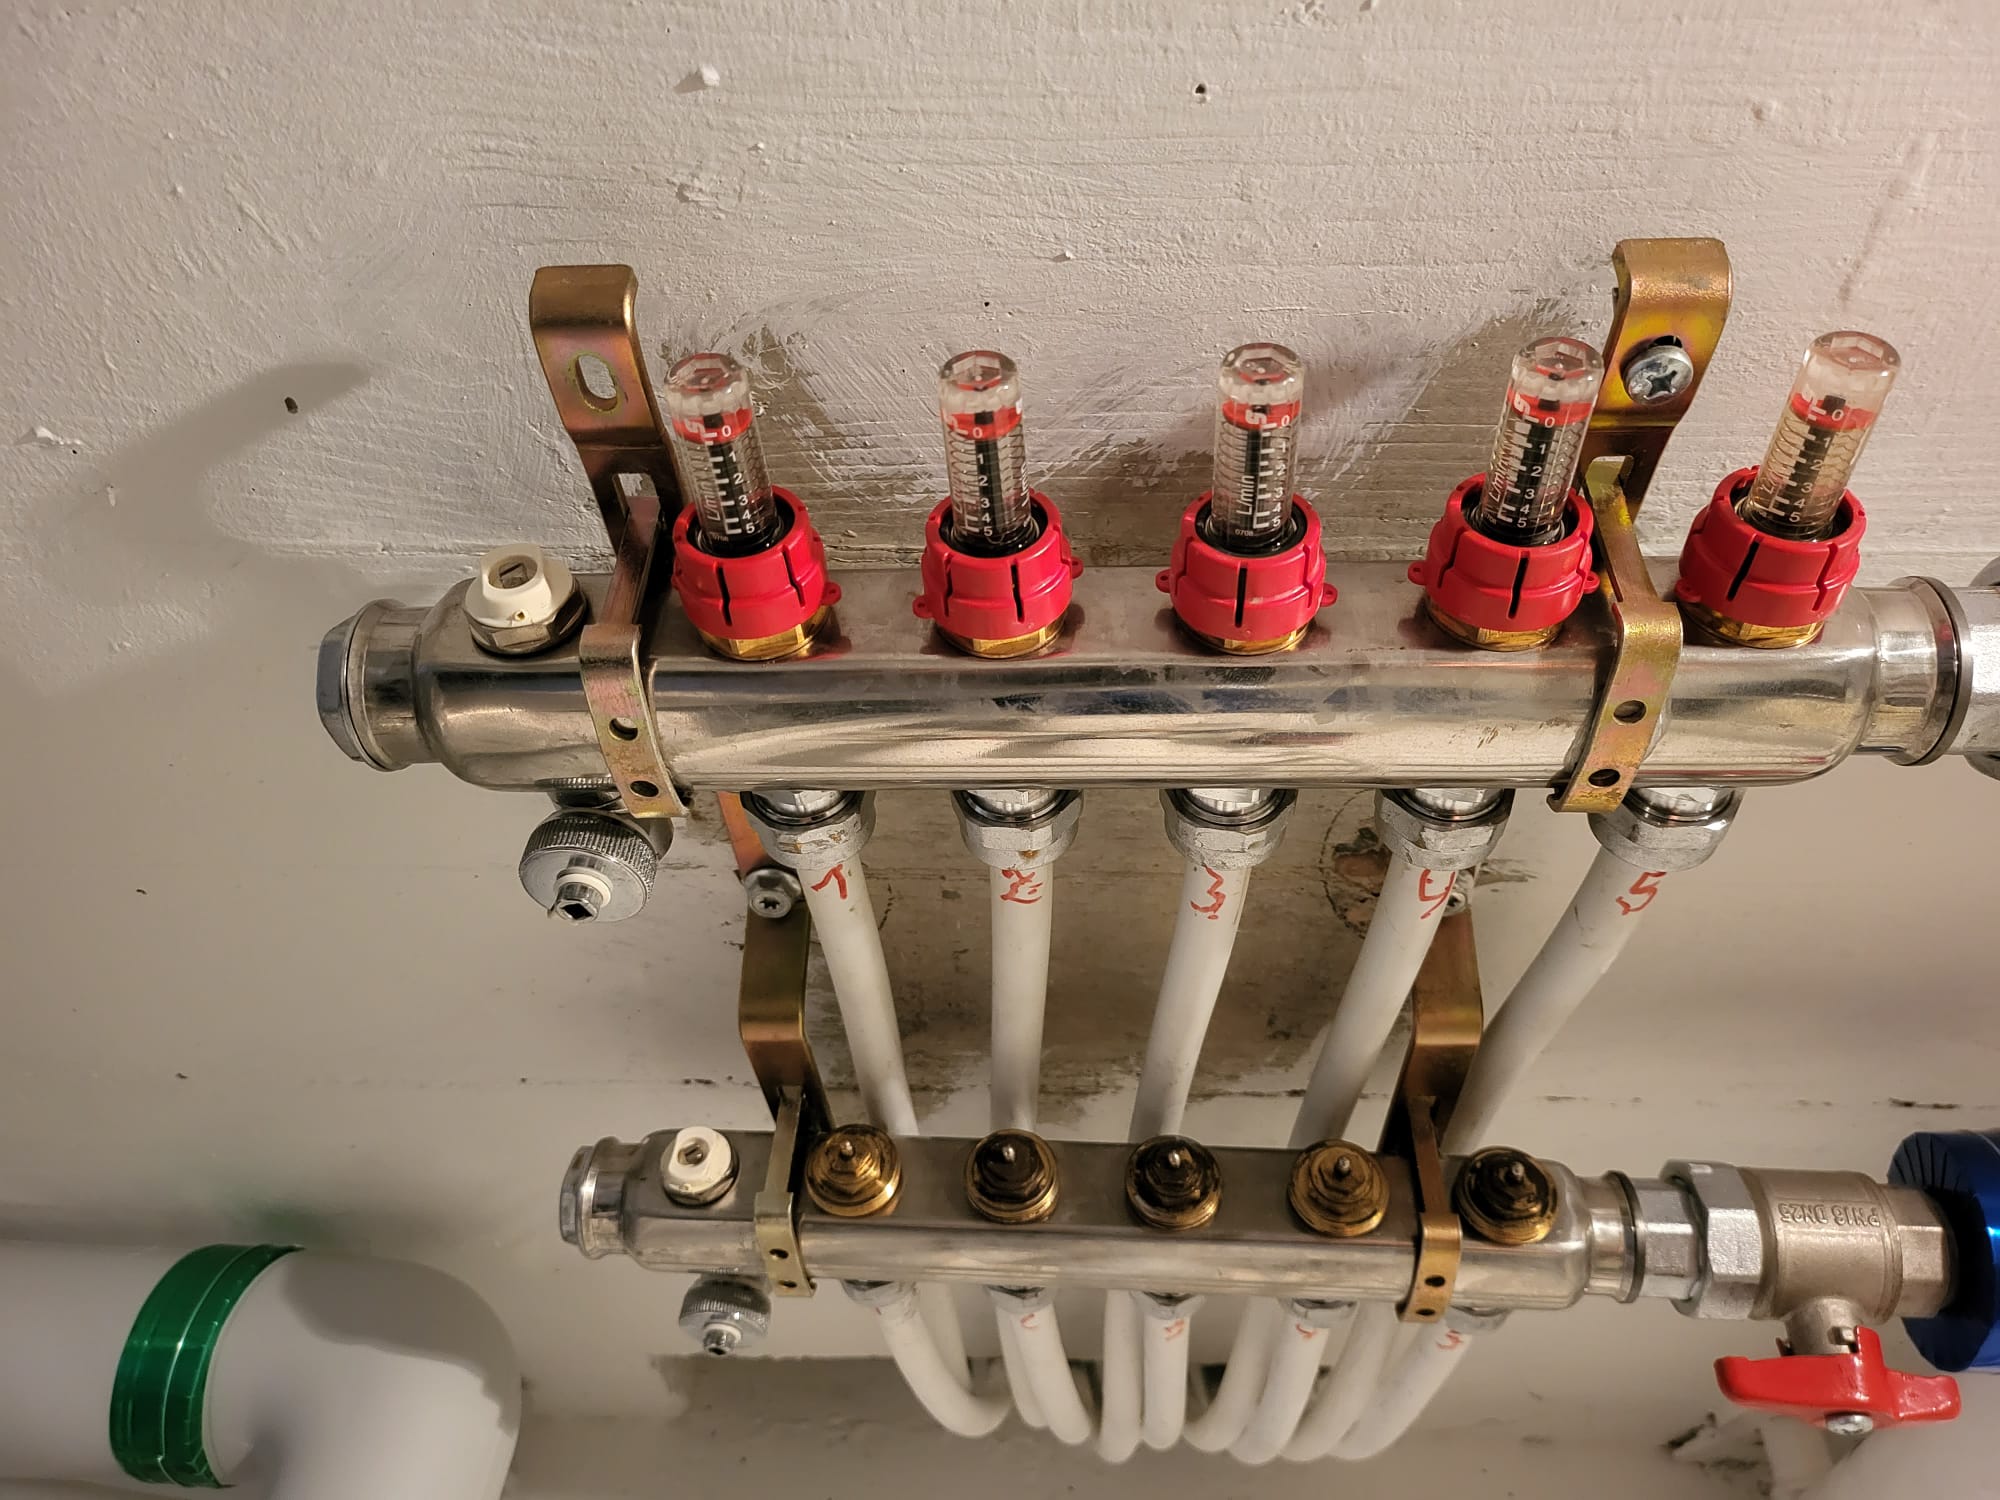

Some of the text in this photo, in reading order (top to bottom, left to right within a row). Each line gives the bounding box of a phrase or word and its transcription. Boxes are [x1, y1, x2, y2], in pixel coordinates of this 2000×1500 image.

[1832, 408, 1844, 420] 0
[1281, 415, 1289, 426] 0
[1544, 417, 1555, 428] 0
[721, 425, 731, 437] 0
[973, 427, 982, 438] 0
[1280, 441, 1286, 453] 1
[1824, 437, 1831, 448] 1
[1539, 444, 1546, 454] 1
[729, 452, 737, 462] 1
[977, 453, 984, 464] 1
[1811, 459, 1824, 470] 2
[1276, 465, 1285, 476] 2
[1531, 466, 1542, 477] 2
[733, 473, 743, 485] 2
[979, 475, 988, 486] 2
[1274, 487, 1283, 498] 3
[1801, 482, 1813, 493] 3
[1236, 475, 1254, 515] L/min
[1525, 489, 1534, 499] 3
[704, 480, 721, 521] L/min
[739, 494, 748, 506] 3
[981, 498, 990, 509] 3
[1795, 498, 1806, 508] 4
[1273, 503, 1281, 512] 4
[1520, 504, 1529, 514] 4
[743, 510, 752, 520] 4
[981, 513, 991, 523] 4
[1790, 513, 1800, 522] 5
[1272, 516, 1280, 527] 5
[1517, 518, 1527, 528] 5
[746, 523, 755, 534] 5
[983, 526, 992, 537] 5
[811, 863, 847, 900] 1
[1191, 865, 1225, 917] 3
[1616, 871, 1667, 915] 5
[1777, 1203, 1881, 1228] PN16 DN25
